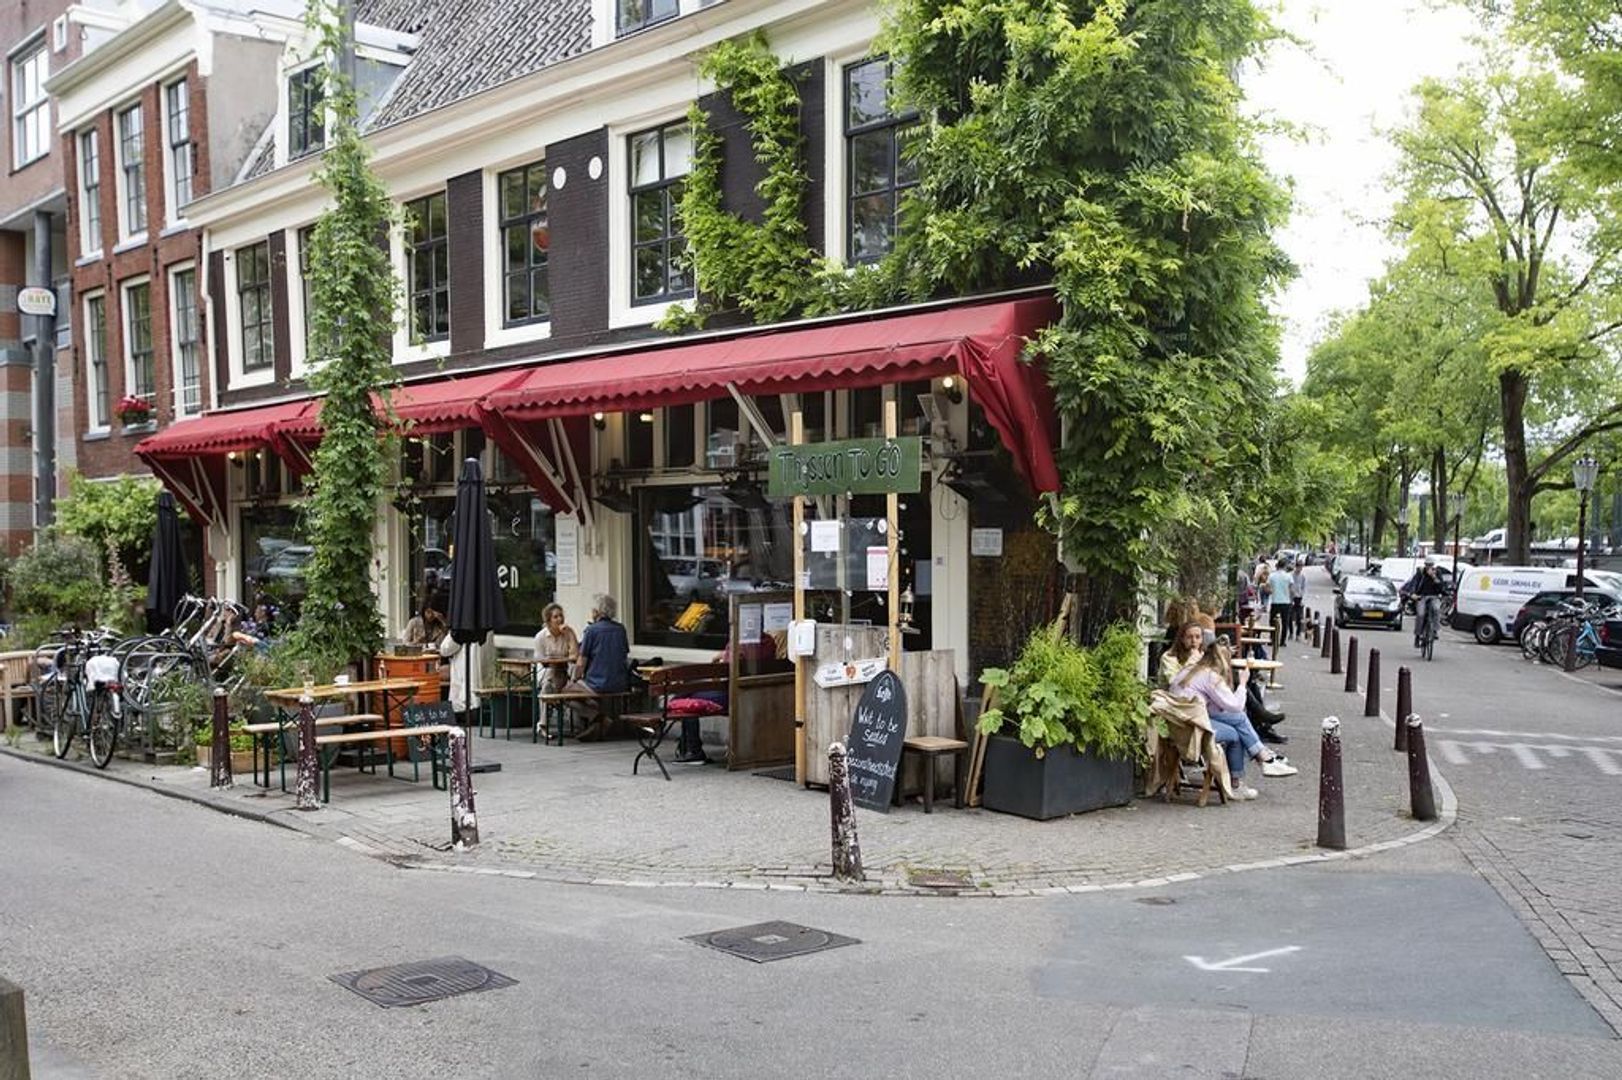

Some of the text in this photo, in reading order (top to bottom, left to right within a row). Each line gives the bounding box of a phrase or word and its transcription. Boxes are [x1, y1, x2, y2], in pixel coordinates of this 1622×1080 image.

[848, 447, 870, 480] TO
[875, 444, 901, 478] GO
[875, 713, 885, 729] to
[887, 717, 899, 733] be
